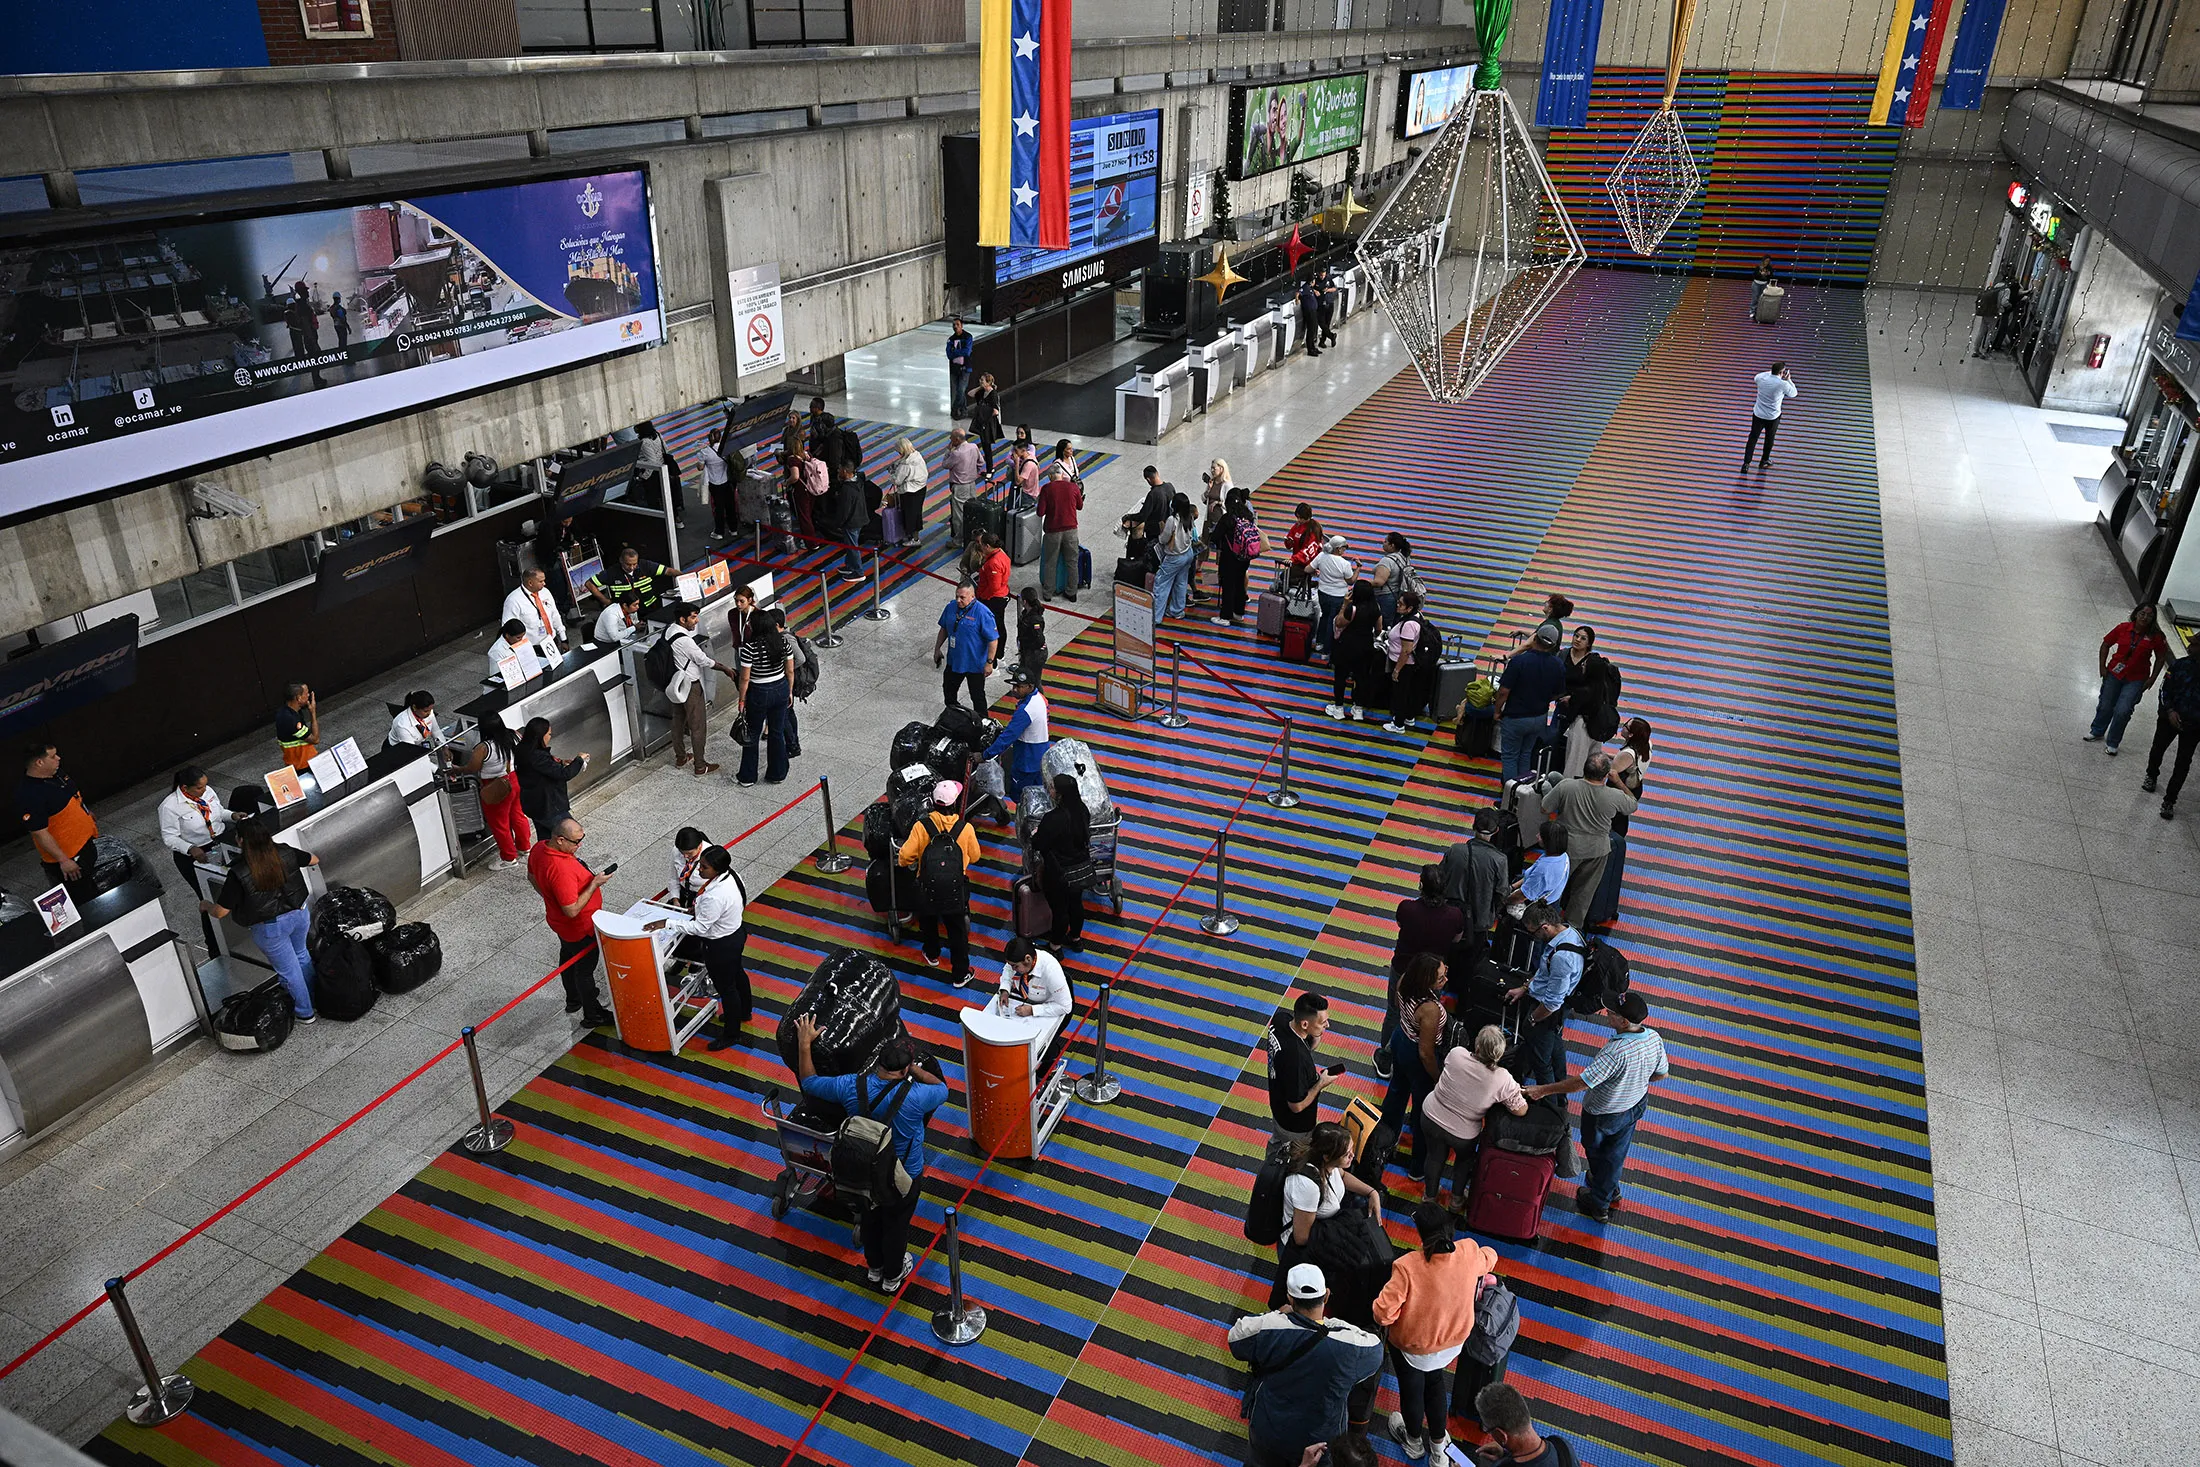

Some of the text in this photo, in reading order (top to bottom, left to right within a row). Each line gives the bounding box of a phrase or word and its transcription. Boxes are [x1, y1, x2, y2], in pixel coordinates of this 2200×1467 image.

[1108, 128, 1146, 151] SINIV
[1127, 149, 1154, 168] 11:58
[600, 230, 625, 243] Navegan
[608, 244, 624, 256] Mar
[1062, 259, 1105, 289] SAMSUNG
[411, 335, 425, 343] +58
[424, 331, 442, 342] 0424
[442, 328, 454, 337] 185
[473, 321, 485, 330] +58
[485, 318, 500, 328] 0424
[500, 315, 512, 324] 273
[512, 312, 527, 321] 9681
[254, 351, 348, 379] WWW.OCAMAR.COM.VE
[114, 404, 182, 428] @ocamar_ve
[47, 425, 90, 443] ocamar
[0, 643, 131, 709] onviasa
